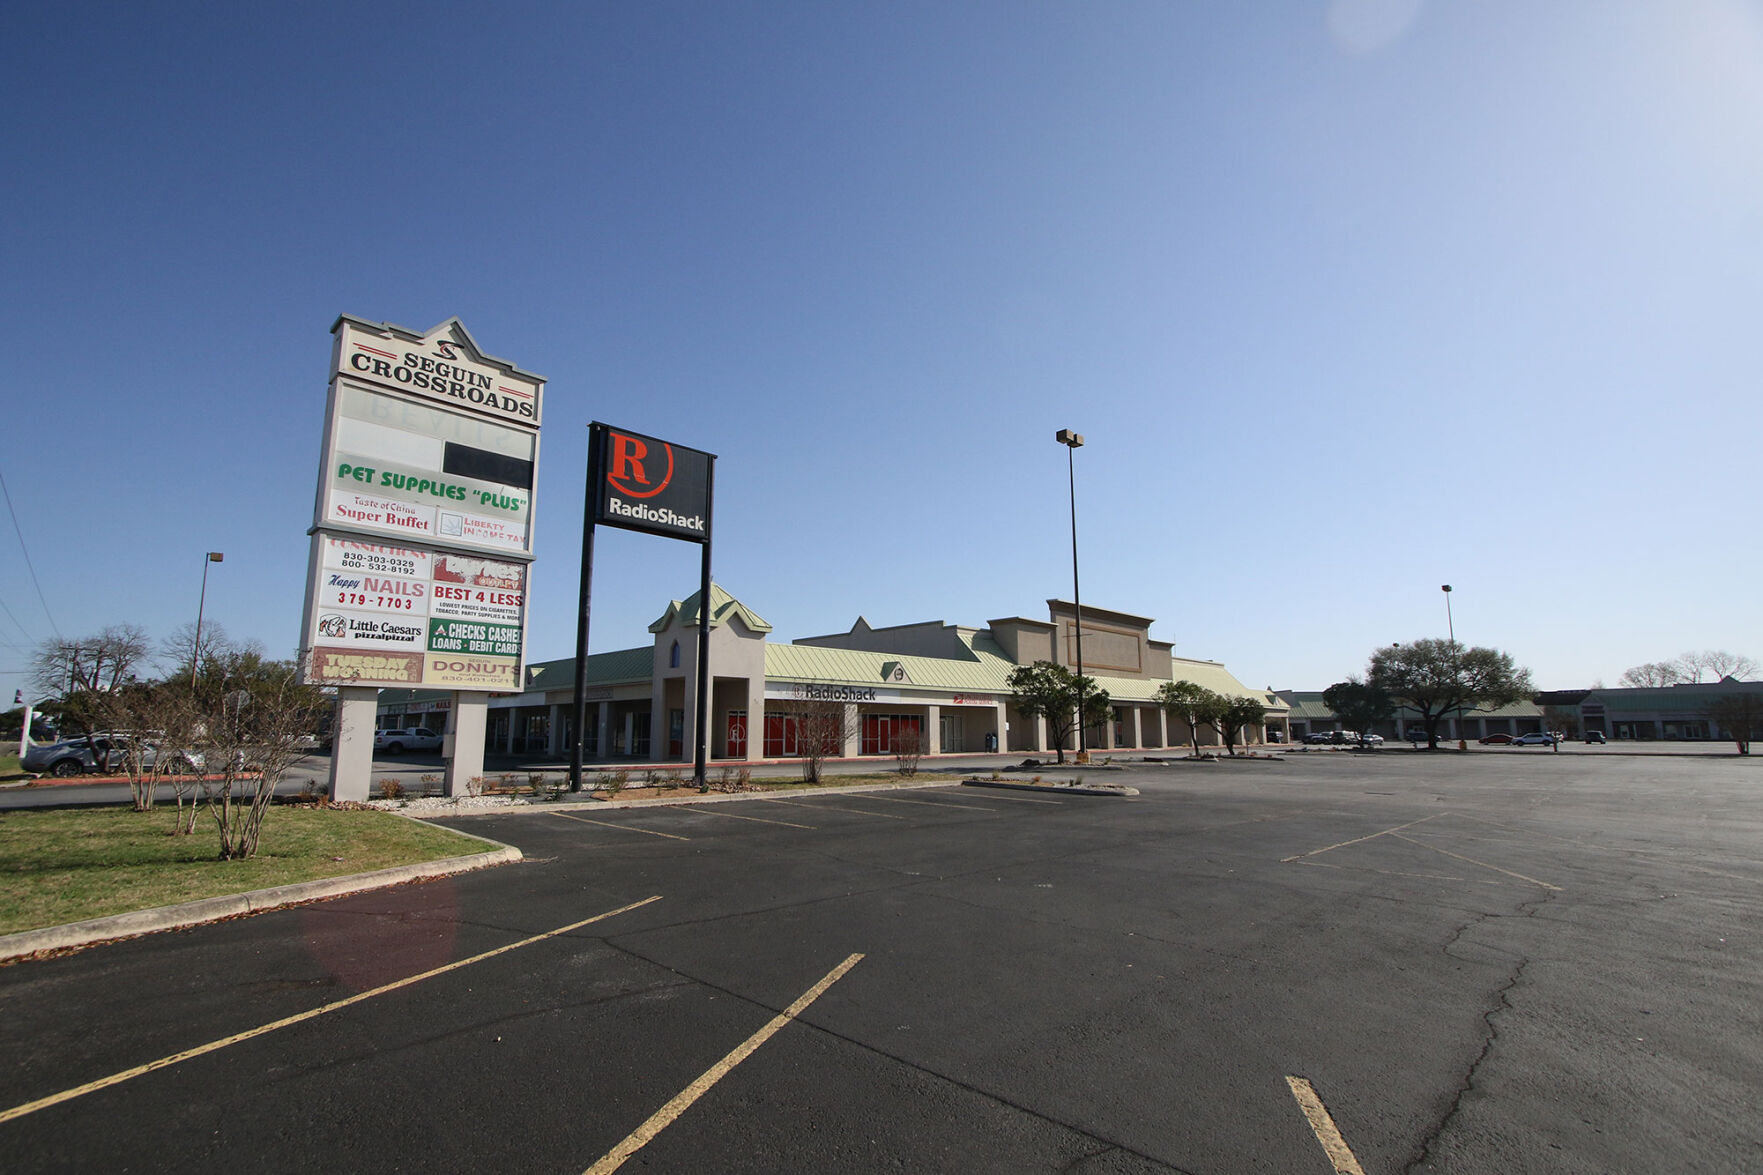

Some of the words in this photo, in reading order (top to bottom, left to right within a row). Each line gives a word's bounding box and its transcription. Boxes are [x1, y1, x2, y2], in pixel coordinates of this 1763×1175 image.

[404, 352, 493, 390] SEGUIN
[351, 353, 533, 418] CROSSROADS
[338, 463, 376, 483] PET
[381, 472, 467, 501] SUPPLIES
[355, 496, 378, 508] Taste
[380, 501, 389, 510] of
[391, 503, 416, 514] China
[336, 504, 381, 521] Super
[386, 512, 428, 530] Buffet
[609, 497, 705, 531] RadioShack
[464, 517, 504, 530] LIBERTY
[344, 552, 414, 568] 830-303-0329
[328, 574, 360, 589] Happy
[364, 577, 424, 597] NAILS
[338, 592, 412, 609] 379-7703
[434, 586, 472, 600] BEST
[475, 591, 485, 603] 4
[490, 592, 523, 607] LESS
[349, 619, 378, 632] Little
[381, 622, 422, 636] Caesars
[449, 623, 486, 640] CHECKS
[432, 637, 462, 650] LOANS
[469, 640, 494, 653] DEBIT
[495, 642, 521, 654] CARDS
[325, 654, 410, 669] TUESDAY
[433, 661, 520, 675] DONUTS
[805, 684, 876, 701] RadioShack
